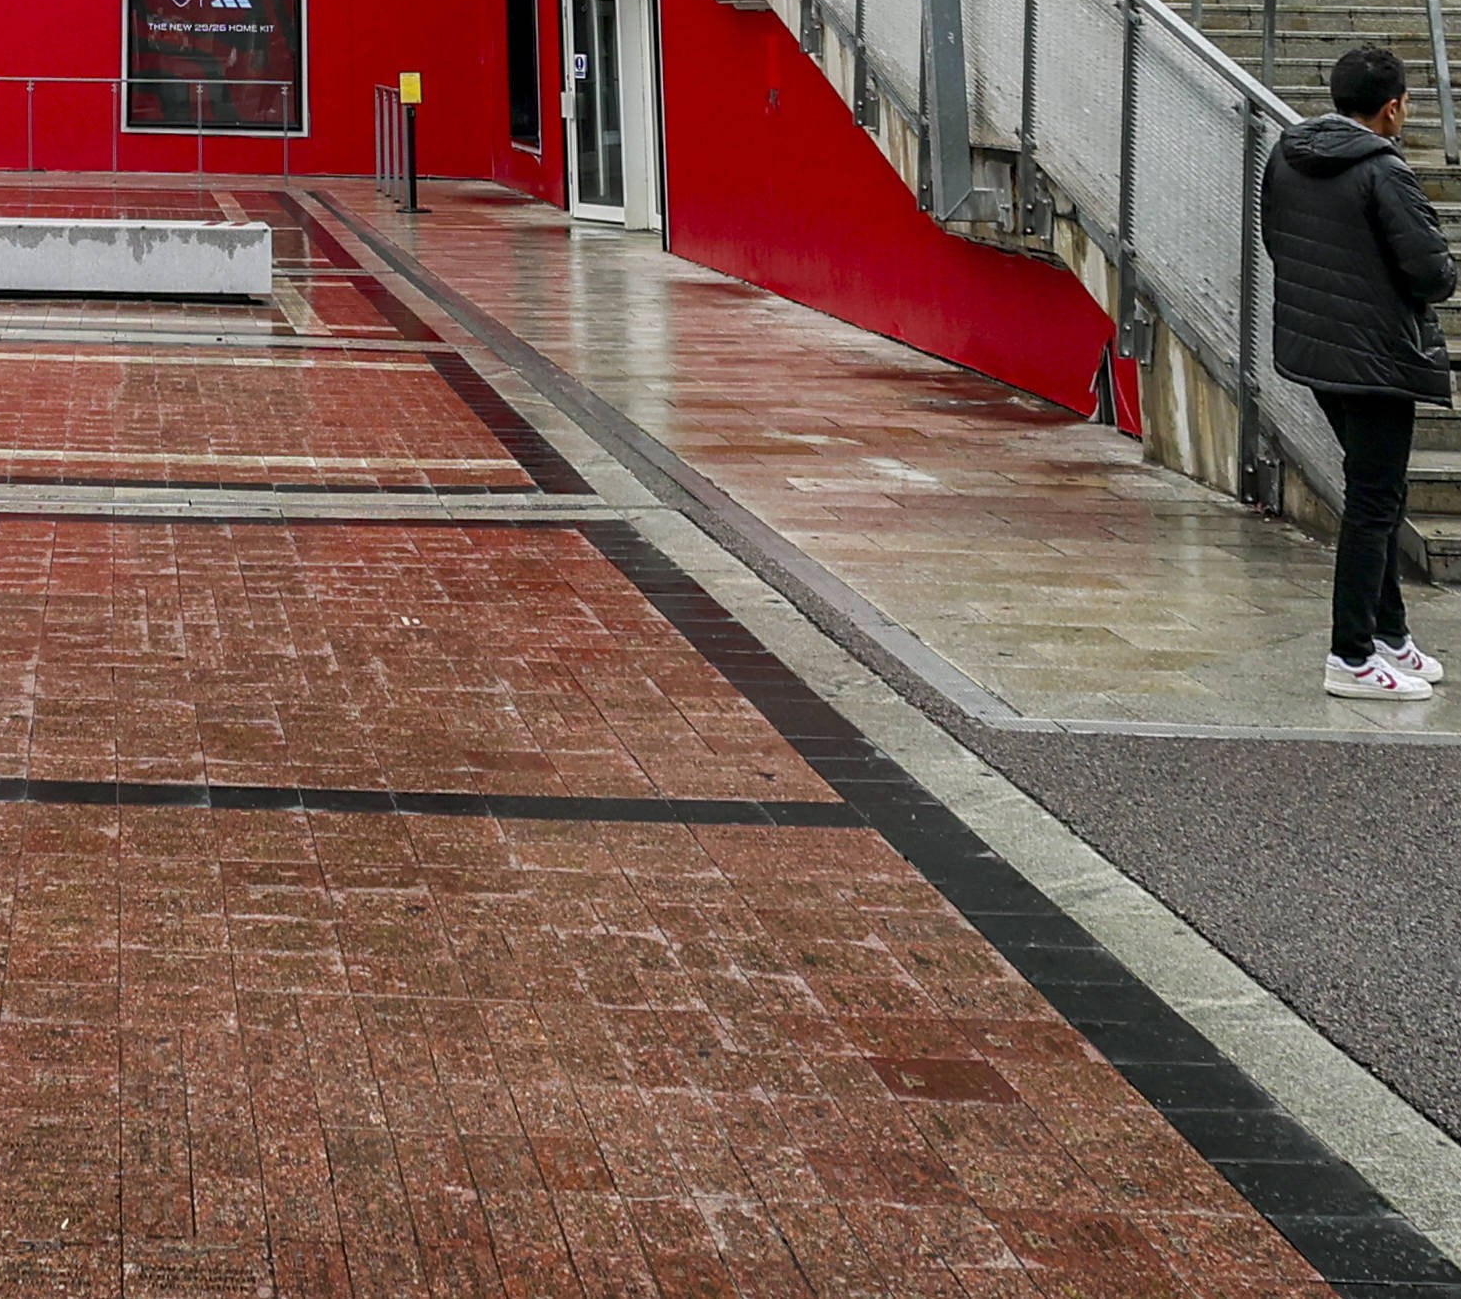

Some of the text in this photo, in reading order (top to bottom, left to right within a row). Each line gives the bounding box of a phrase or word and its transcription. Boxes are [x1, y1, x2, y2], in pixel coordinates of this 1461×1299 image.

[148, 23, 167, 32] THE
[169, 23, 193, 32] NEW
[228, 24, 258, 33] HOME
[259, 24, 276, 33] KIT
